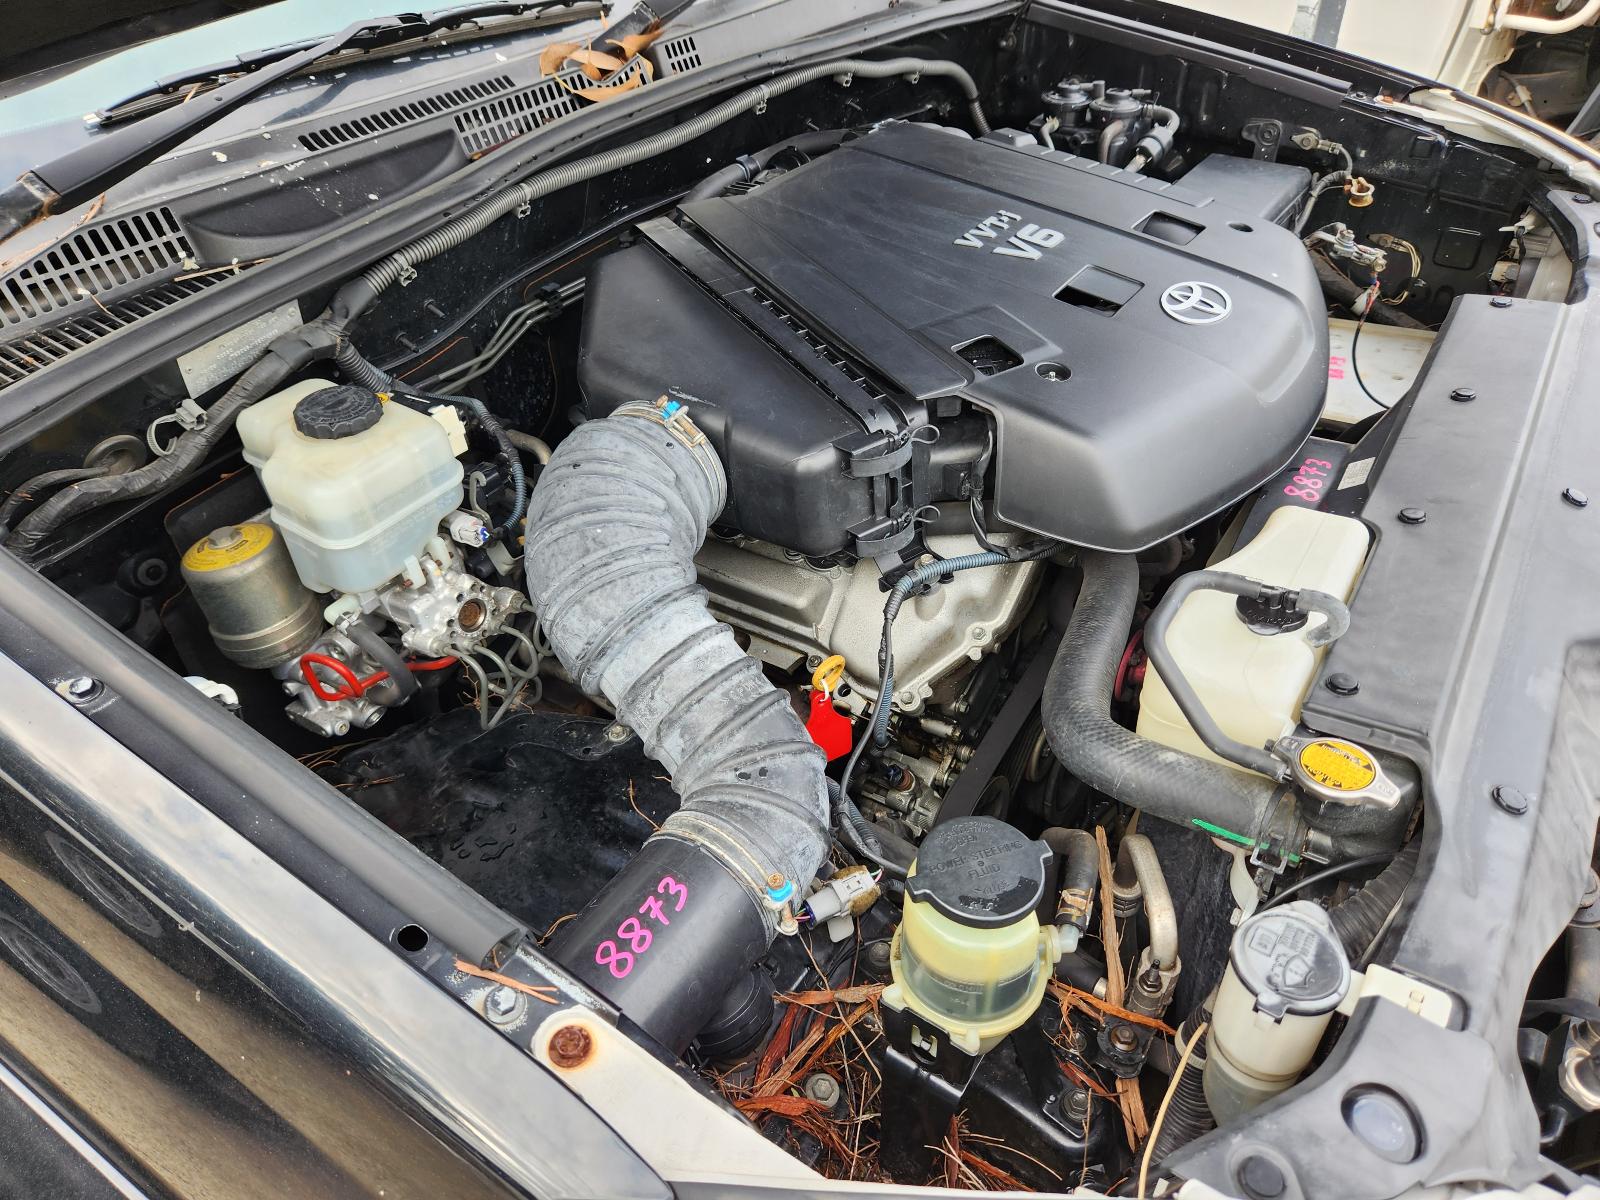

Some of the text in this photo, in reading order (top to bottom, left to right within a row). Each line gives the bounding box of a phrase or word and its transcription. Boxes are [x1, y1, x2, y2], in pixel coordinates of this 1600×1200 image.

[993, 223, 1065, 260] V6
[1284, 458, 1332, 502] 8873
[929, 840, 1024, 875] POWER STEERING
[967, 863, 1001, 879] FLUID
[596, 877, 688, 978] 8873
